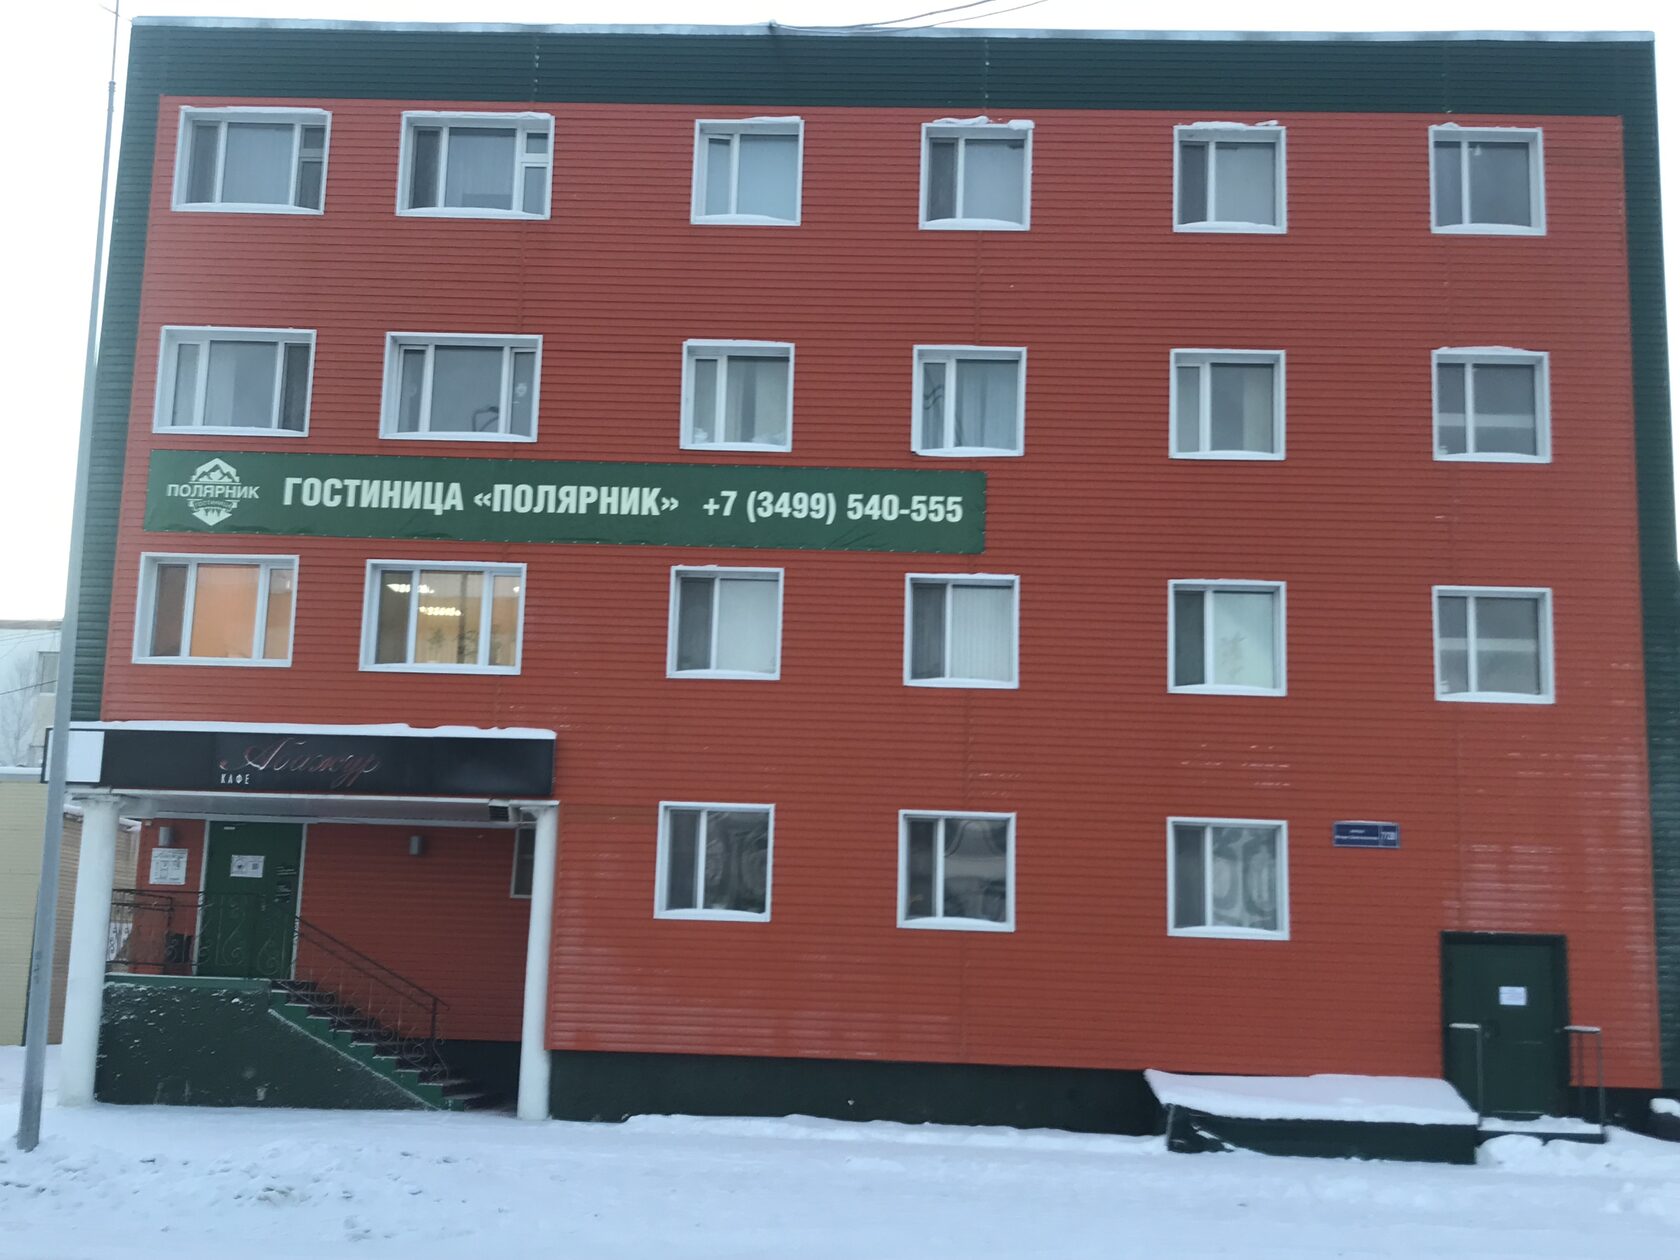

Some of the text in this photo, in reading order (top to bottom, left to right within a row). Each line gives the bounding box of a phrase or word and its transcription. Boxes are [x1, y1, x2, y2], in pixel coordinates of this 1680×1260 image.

[167, 484, 260, 500] ПОЛЯРНИК
[283, 477, 963, 525] ГОСТИНИЦА «ПОЛЯРНИК» +7 (3499) 540-555
[220, 773, 250, 785] КАФЕ
